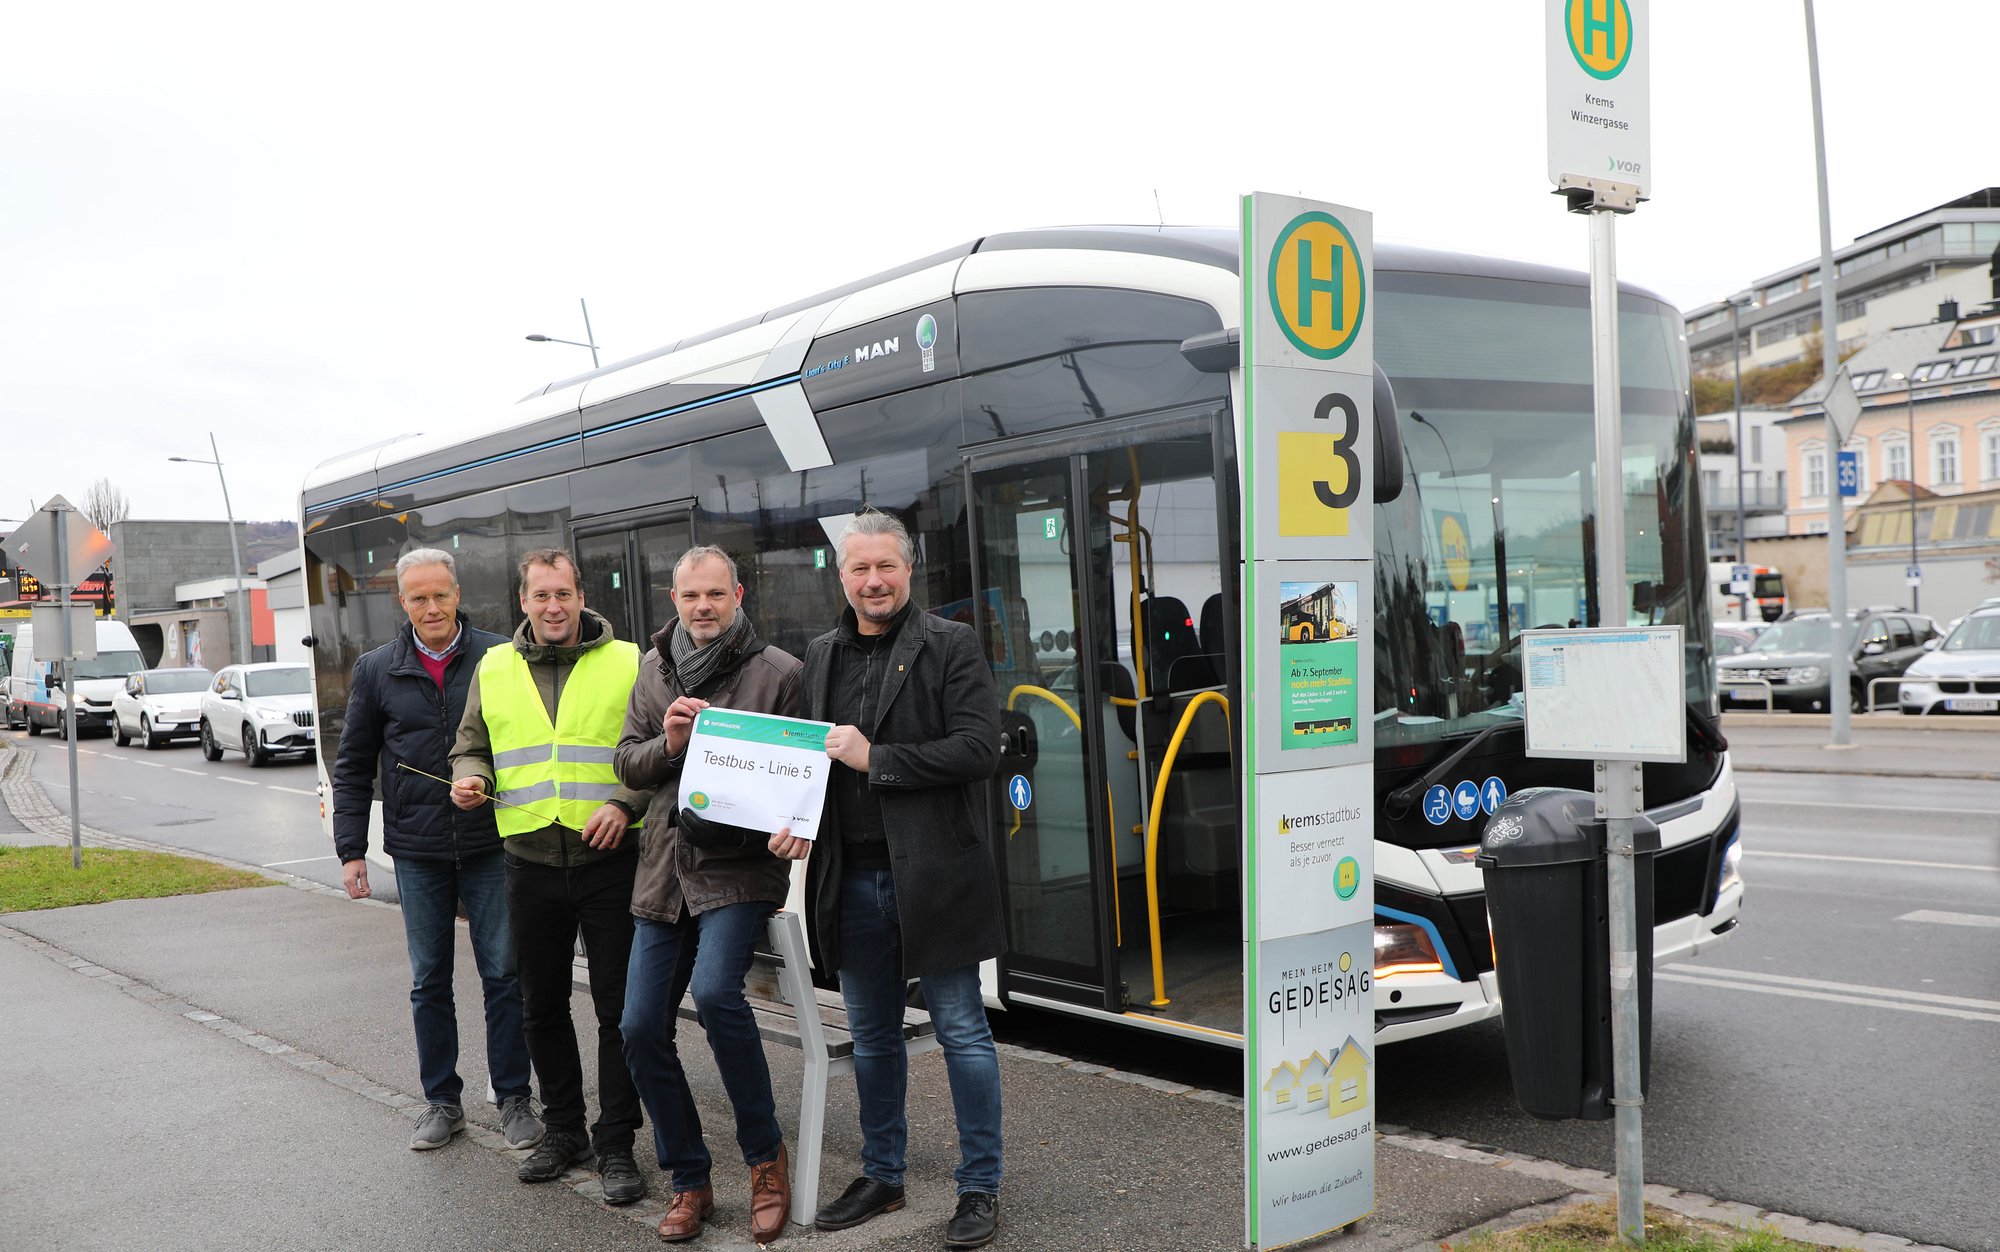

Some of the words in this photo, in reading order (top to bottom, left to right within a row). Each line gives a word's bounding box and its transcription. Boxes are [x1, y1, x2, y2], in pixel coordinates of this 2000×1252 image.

[1584, 0, 1615, 60] H
[1585, 94, 1615, 109] Krems
[1571, 110, 1629, 130] Winzergasse
[1616, 160, 1641, 174] VOR
[1298, 239, 1344, 331] H
[855, 336, 900, 363] MAN
[805, 364, 826, 378] Lion's
[827, 359, 843, 371] City
[844, 355, 850, 365] E
[1312, 392, 1361, 509] 3
[1839, 460, 1856, 487] 35
[1291, 668, 1301, 678] Ab
[1303, 668, 1308, 677] 7.
[1310, 666, 1343, 678] September
[1291, 679, 1308, 689] noch
[1310, 678, 1326, 688] mehr
[1328, 677, 1352, 687] Stadtbus
[710, 721, 741, 730] INFORMATION
[703, 750, 756, 771] Testbus
[768, 760, 799, 777] Linie
[803, 766, 813, 780] 5
[1281, 806, 1361, 832] kremsstadtbus
[1290, 841, 1315, 853] Besser
[1316, 836, 1345, 849] vernetzt
[1290, 855, 1301, 867] als
[1303, 854, 1310, 869] je
[1312, 852, 1333, 864] zuvor.
[1281, 967, 1306, 980] MEIN
[1312, 962, 1334, 974] HEIM
[1269, 970, 1370, 1014] GEDESAG
[1267, 1120, 1372, 1163] www.gedesag.at
[1271, 1191, 1290, 1208] Wir
[1291, 1184, 1318, 1204] bauen
[1320, 1176, 1332, 1193] die
[1334, 1169, 1363, 1190] Zukunft
